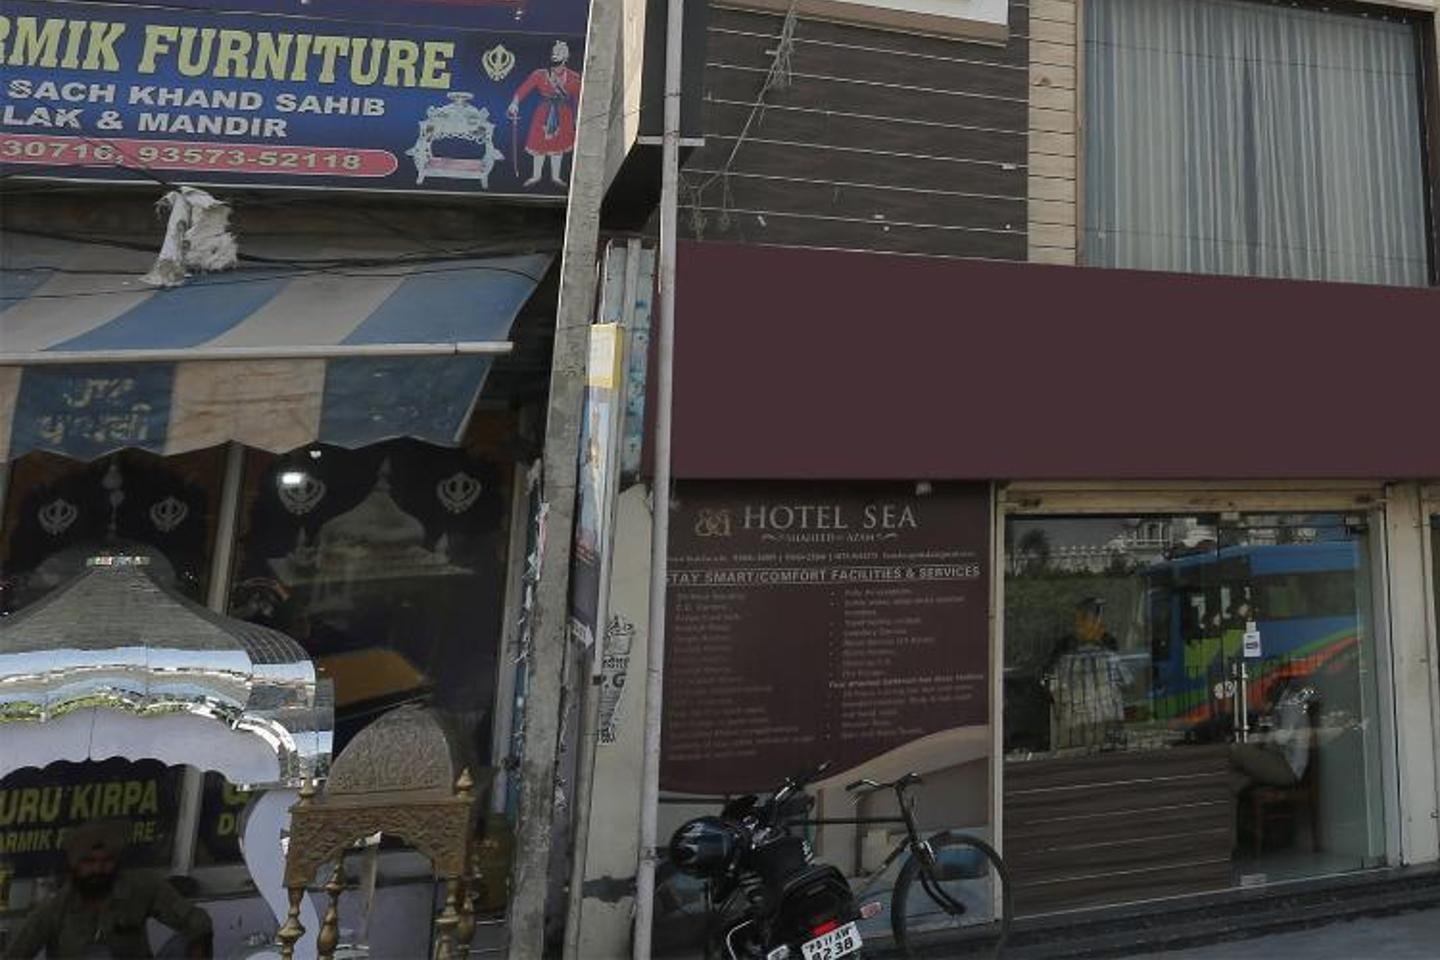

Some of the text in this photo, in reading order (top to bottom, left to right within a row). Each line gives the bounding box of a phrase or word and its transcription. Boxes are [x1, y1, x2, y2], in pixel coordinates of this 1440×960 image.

[138, 25, 455, 89] FURNITURE
[8, 79, 385, 116] SACH KHAND SAHIB
[3, 105, 287, 137] LAK & MANDIR
[139, 146, 360, 169] 93573-52118
[743, 504, 917, 530] HOTEL SEA
[666, 572, 700, 584] TAY
[831, 566, 900, 581] FACILITIES
[919, 564, 981, 578] SERVICES
[71, 780, 158, 820] KIRPA
